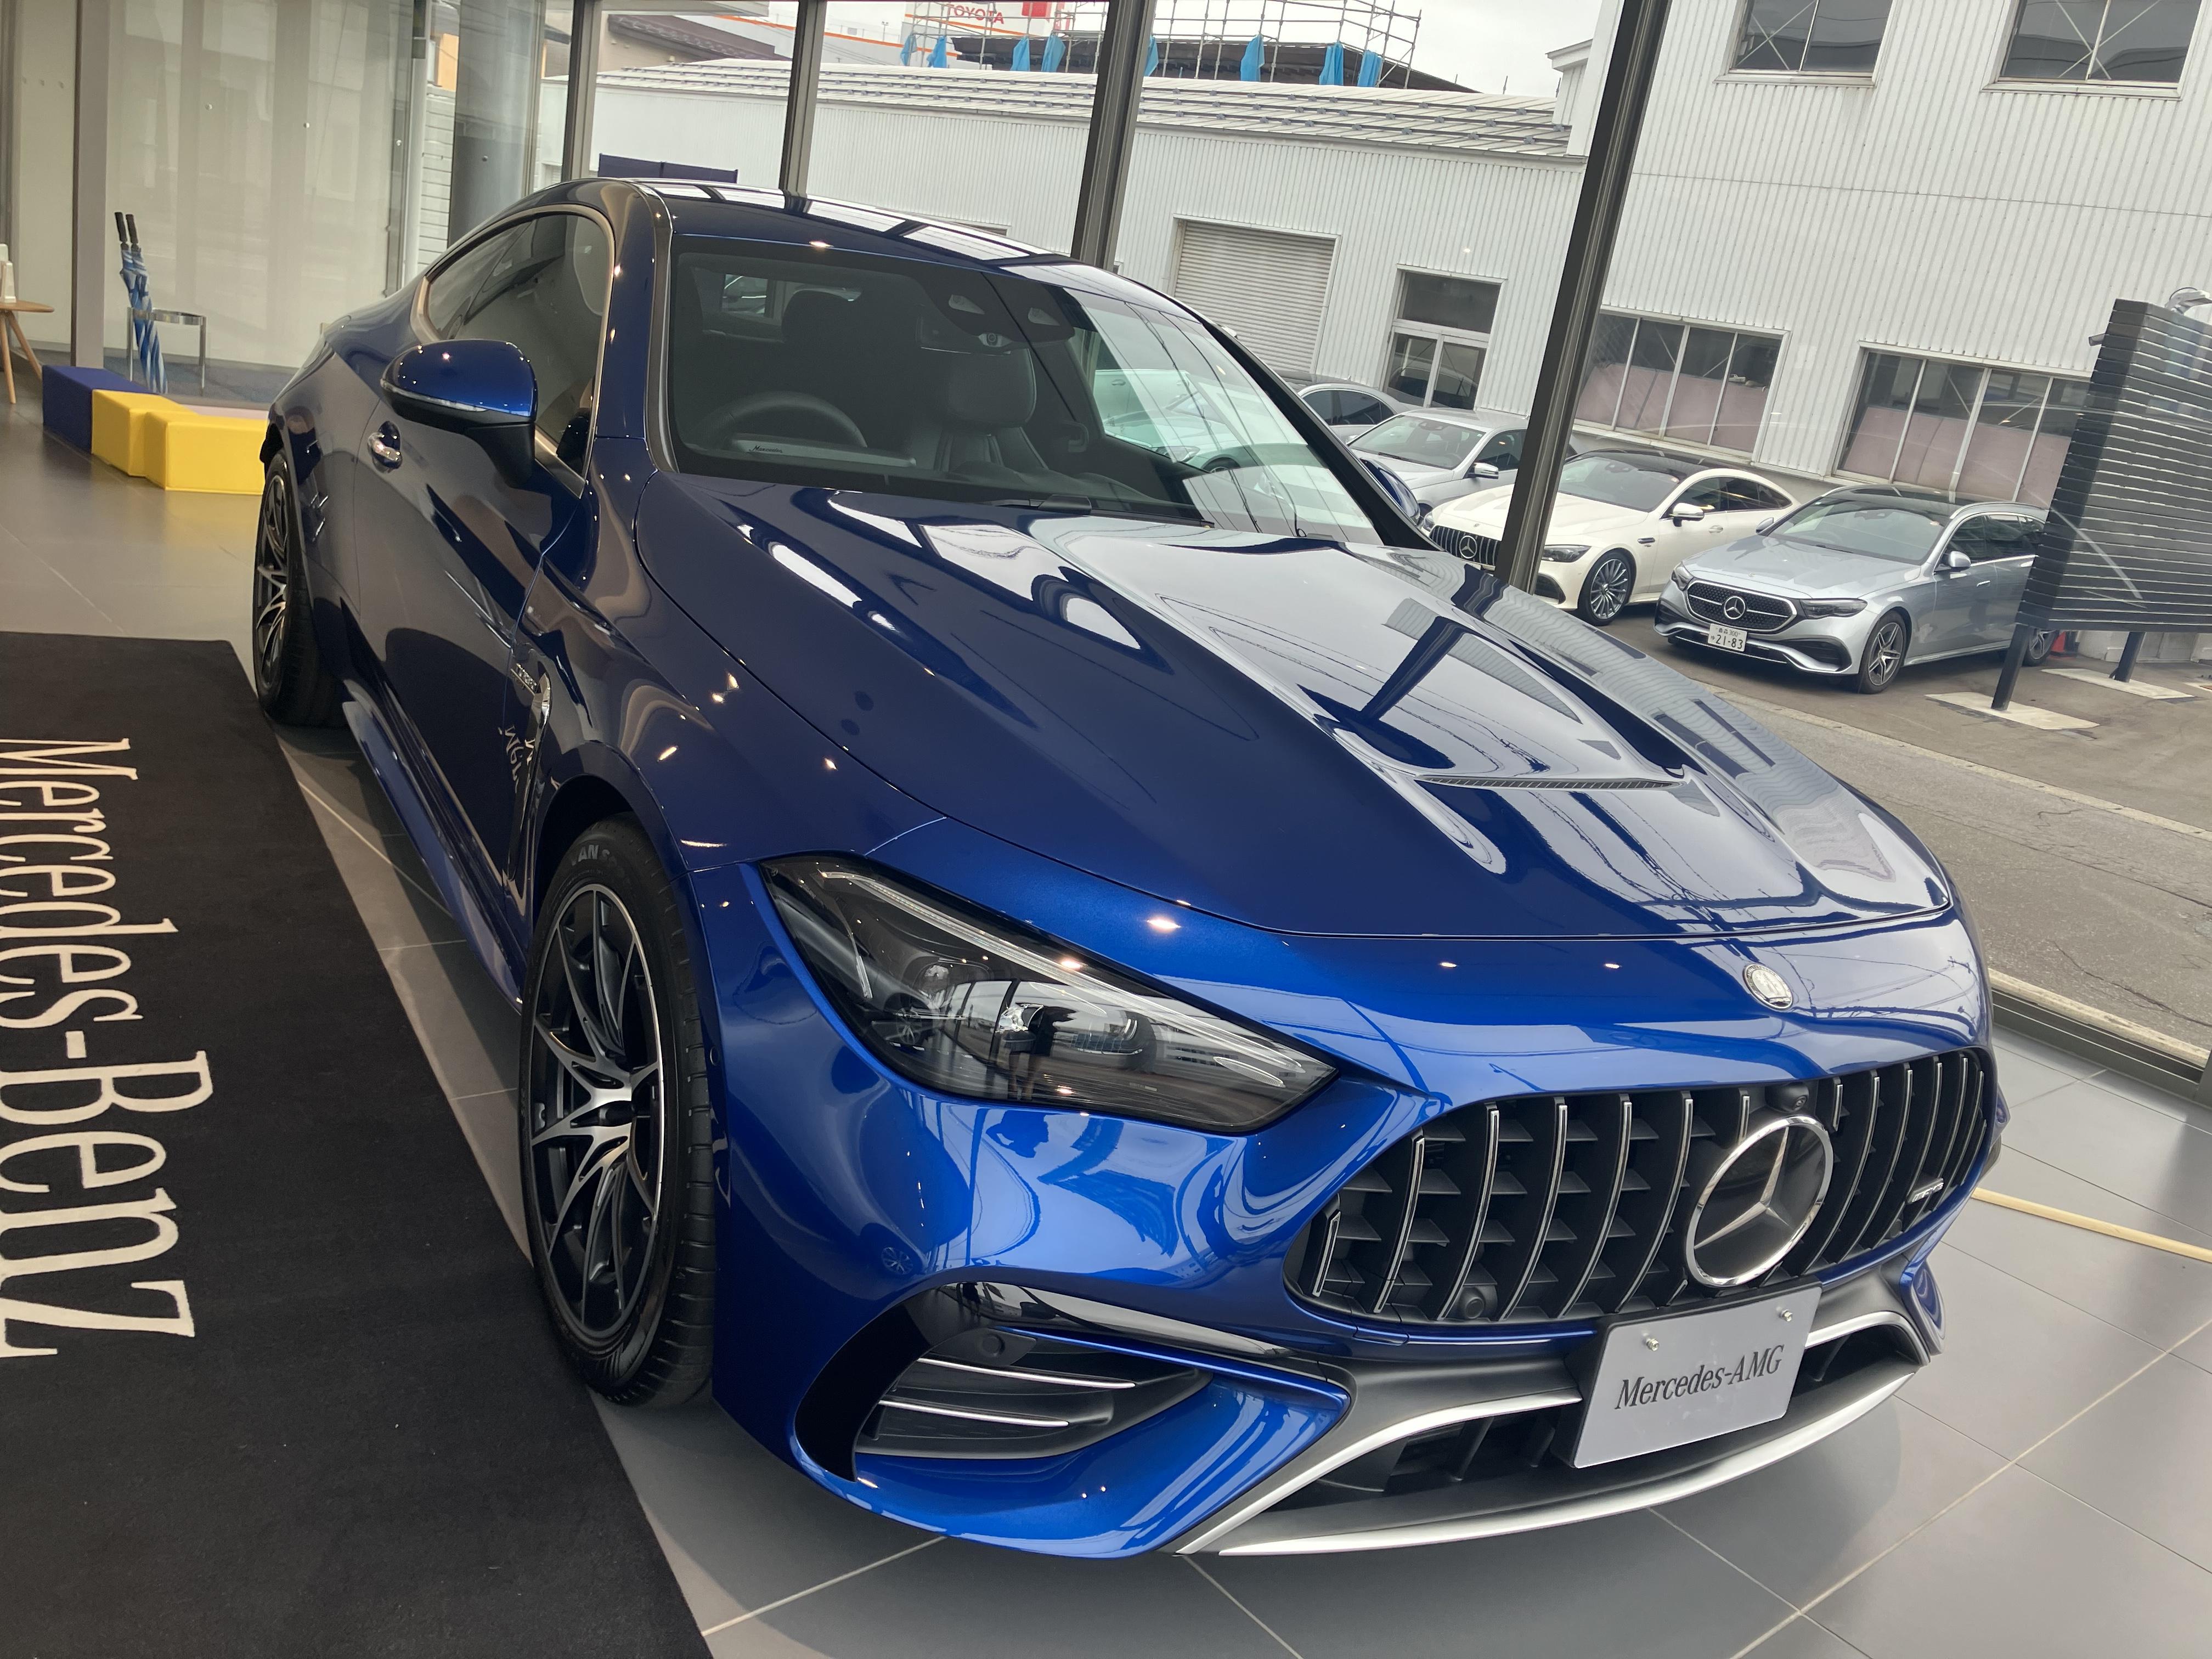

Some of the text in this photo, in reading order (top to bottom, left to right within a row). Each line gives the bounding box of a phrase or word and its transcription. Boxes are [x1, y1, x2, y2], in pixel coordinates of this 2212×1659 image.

[946, 4, 1005, 24] TOYOTA
[1716, 634, 1743, 649] 21-83
[0, 737, 213, 1359] Mercedes-Benz
[1614, 1344, 1785, 1410] Mercedes-AMG
